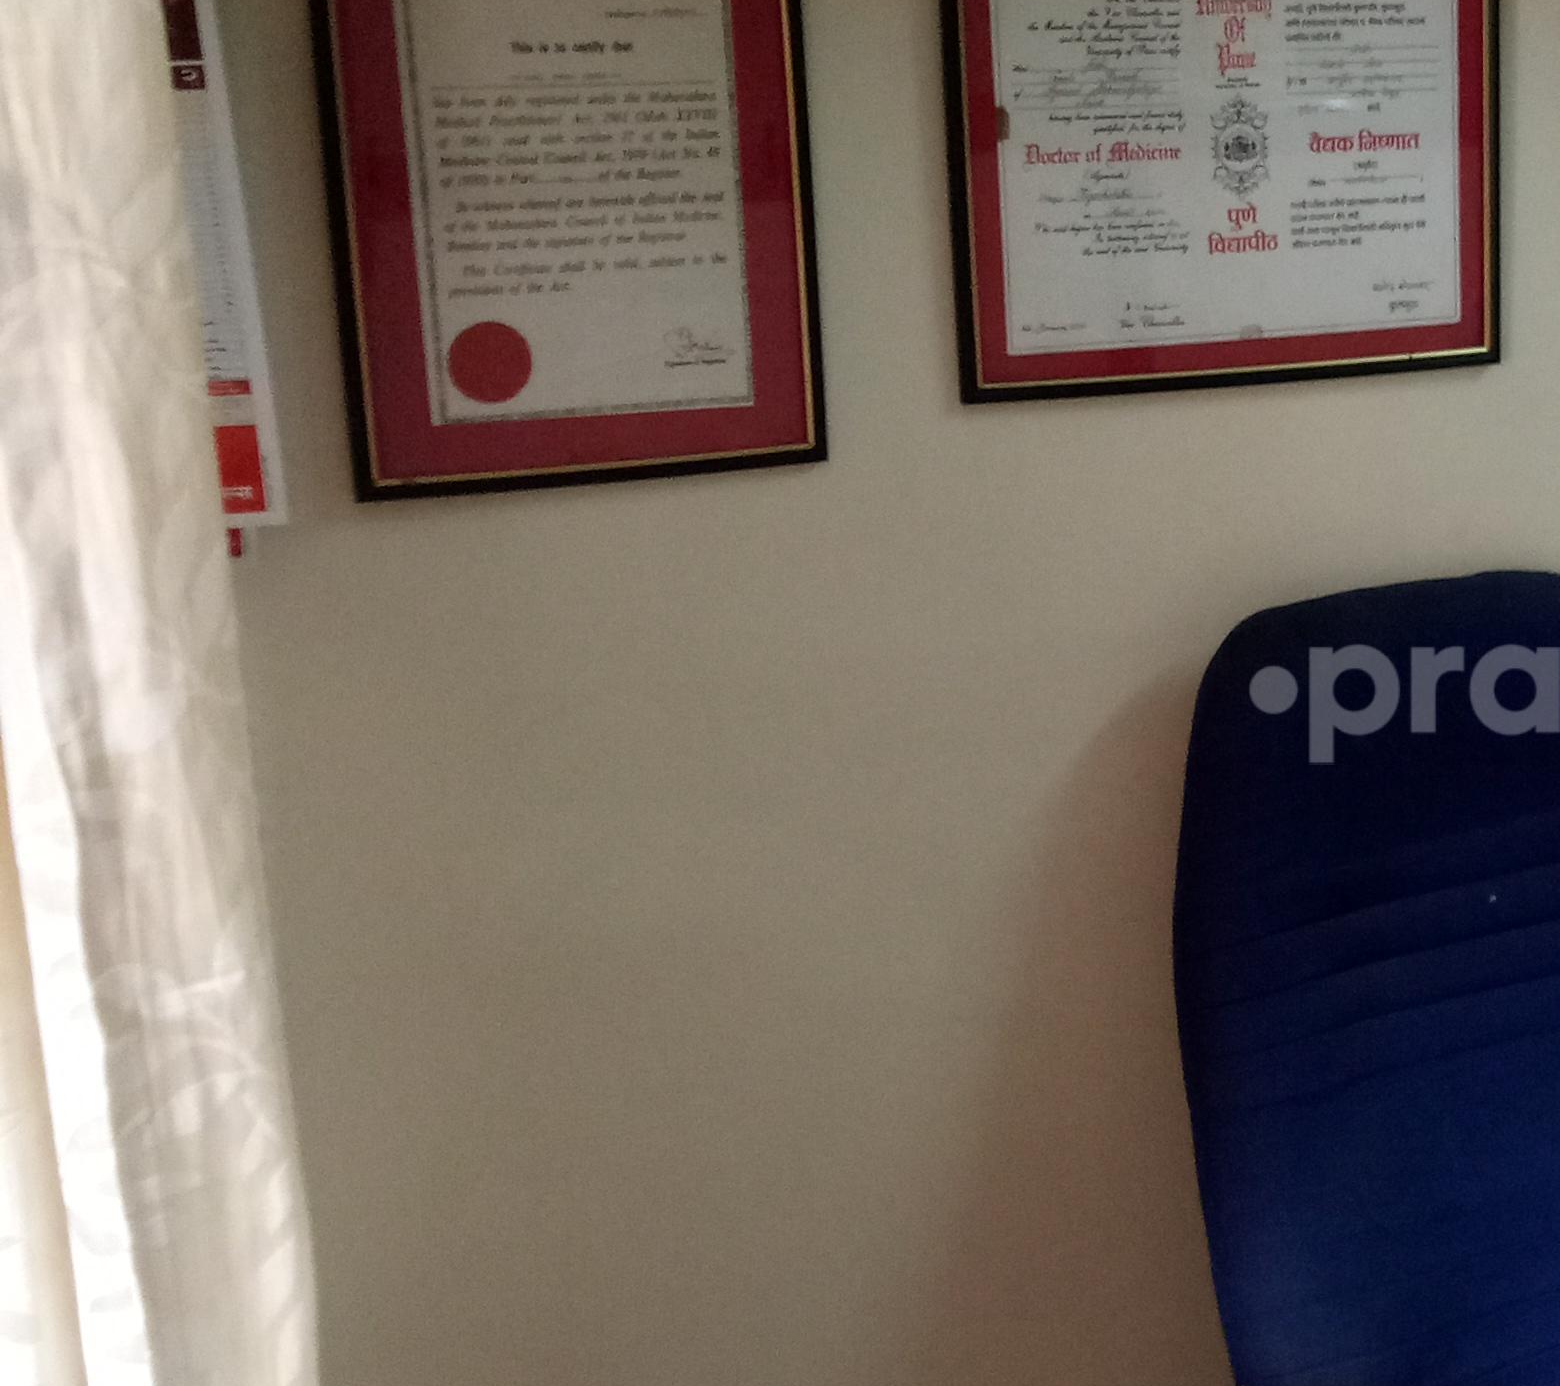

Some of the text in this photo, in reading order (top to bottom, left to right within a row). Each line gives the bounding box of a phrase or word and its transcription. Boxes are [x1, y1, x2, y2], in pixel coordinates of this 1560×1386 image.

[1216, 42, 1257, 78] Pune
[1023, 142, 1082, 165] Doctor
[1107, 139, 1183, 164] Medicine
[1226, 201, 1259, 232] पुणे
[1207, 229, 1280, 256] विद्यापीठ
